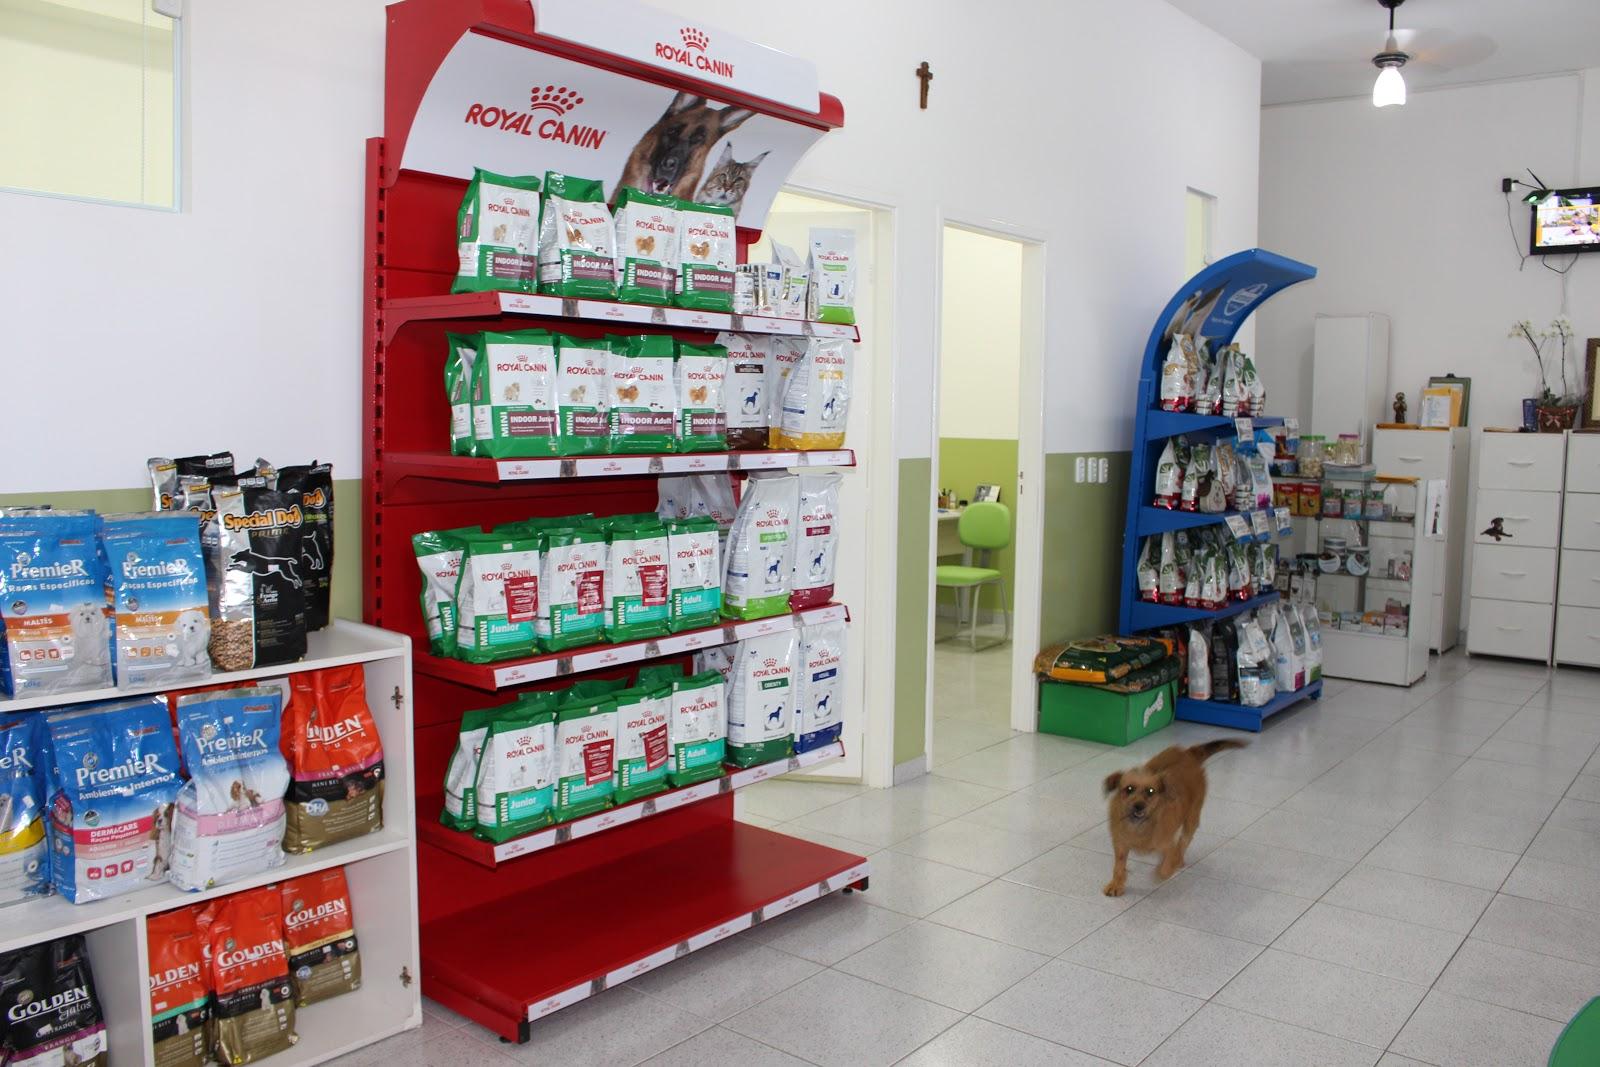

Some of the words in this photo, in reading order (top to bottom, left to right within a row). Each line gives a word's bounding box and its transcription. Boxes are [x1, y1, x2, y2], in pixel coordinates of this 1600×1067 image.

[656, 42, 694, 67] ROYAL
[696, 55, 734, 78] CANIN
[466, 103, 532, 136] ROYAL
[539, 118, 606, 150] CANIN
[488, 204, 509, 214] ROYAL
[580, 217, 605, 225] CANIN
[636, 220, 656, 231] ROYAL
[688, 228, 709, 237] ROYAL
[486, 252, 494, 277] MINI
[496, 256, 518, 264] INDOOR
[628, 263, 636, 286] MINI
[637, 269, 662, 278] INDOOR
[694, 273, 719, 282] INDOOR
[497, 364, 522, 372] ROYAL
[524, 364, 547, 372] CANIN
[566, 366, 590, 375] ROYAL
[500, 412, 509, 438] MINI
[611, 412, 619, 435] MINI
[224, 511, 273, 533] Special
[275, 505, 301, 526] Dog
[756, 520, 774, 528] ROYAL
[640, 554, 660, 563] CANIN
[558, 561, 577, 572] ROYAL
[578, 560, 597, 570] CANIN
[482, 572, 505, 581] ROYAL
[507, 568, 532, 578] CANIN
[684, 596, 702, 604] Adult
[442, 606, 454, 631] MINI
[480, 620, 488, 646] MINI
[490, 624, 520, 634] Junior
[809, 660, 824, 668] ROYAL
[753, 668, 770, 678] ROYAL
[771, 666, 791, 676] CANIN
[680, 705, 700, 714] ROYAL
[627, 719, 647, 728] ROYAL
[648, 715, 665, 725] CANIN
[566, 735, 585, 744] ROYAL
[586, 730, 608, 740] CANIN
[506, 750, 526, 760] ROYAL
[526, 744, 545, 754] CANIN
[688, 748, 706, 758] Adult
[76, 754, 168, 787] PremieR
[305, 802, 329, 814] DHA
[466, 793, 474, 816] MINI
[511, 797, 537, 809] Junior
[501, 798, 509, 822] MINI
[285, 898, 346, 927] GOLDEN
[218, 938, 284, 968] GOLDEN
[149, 962, 200, 989] OLDEN
[8, 985, 89, 1021] GOLDEN
